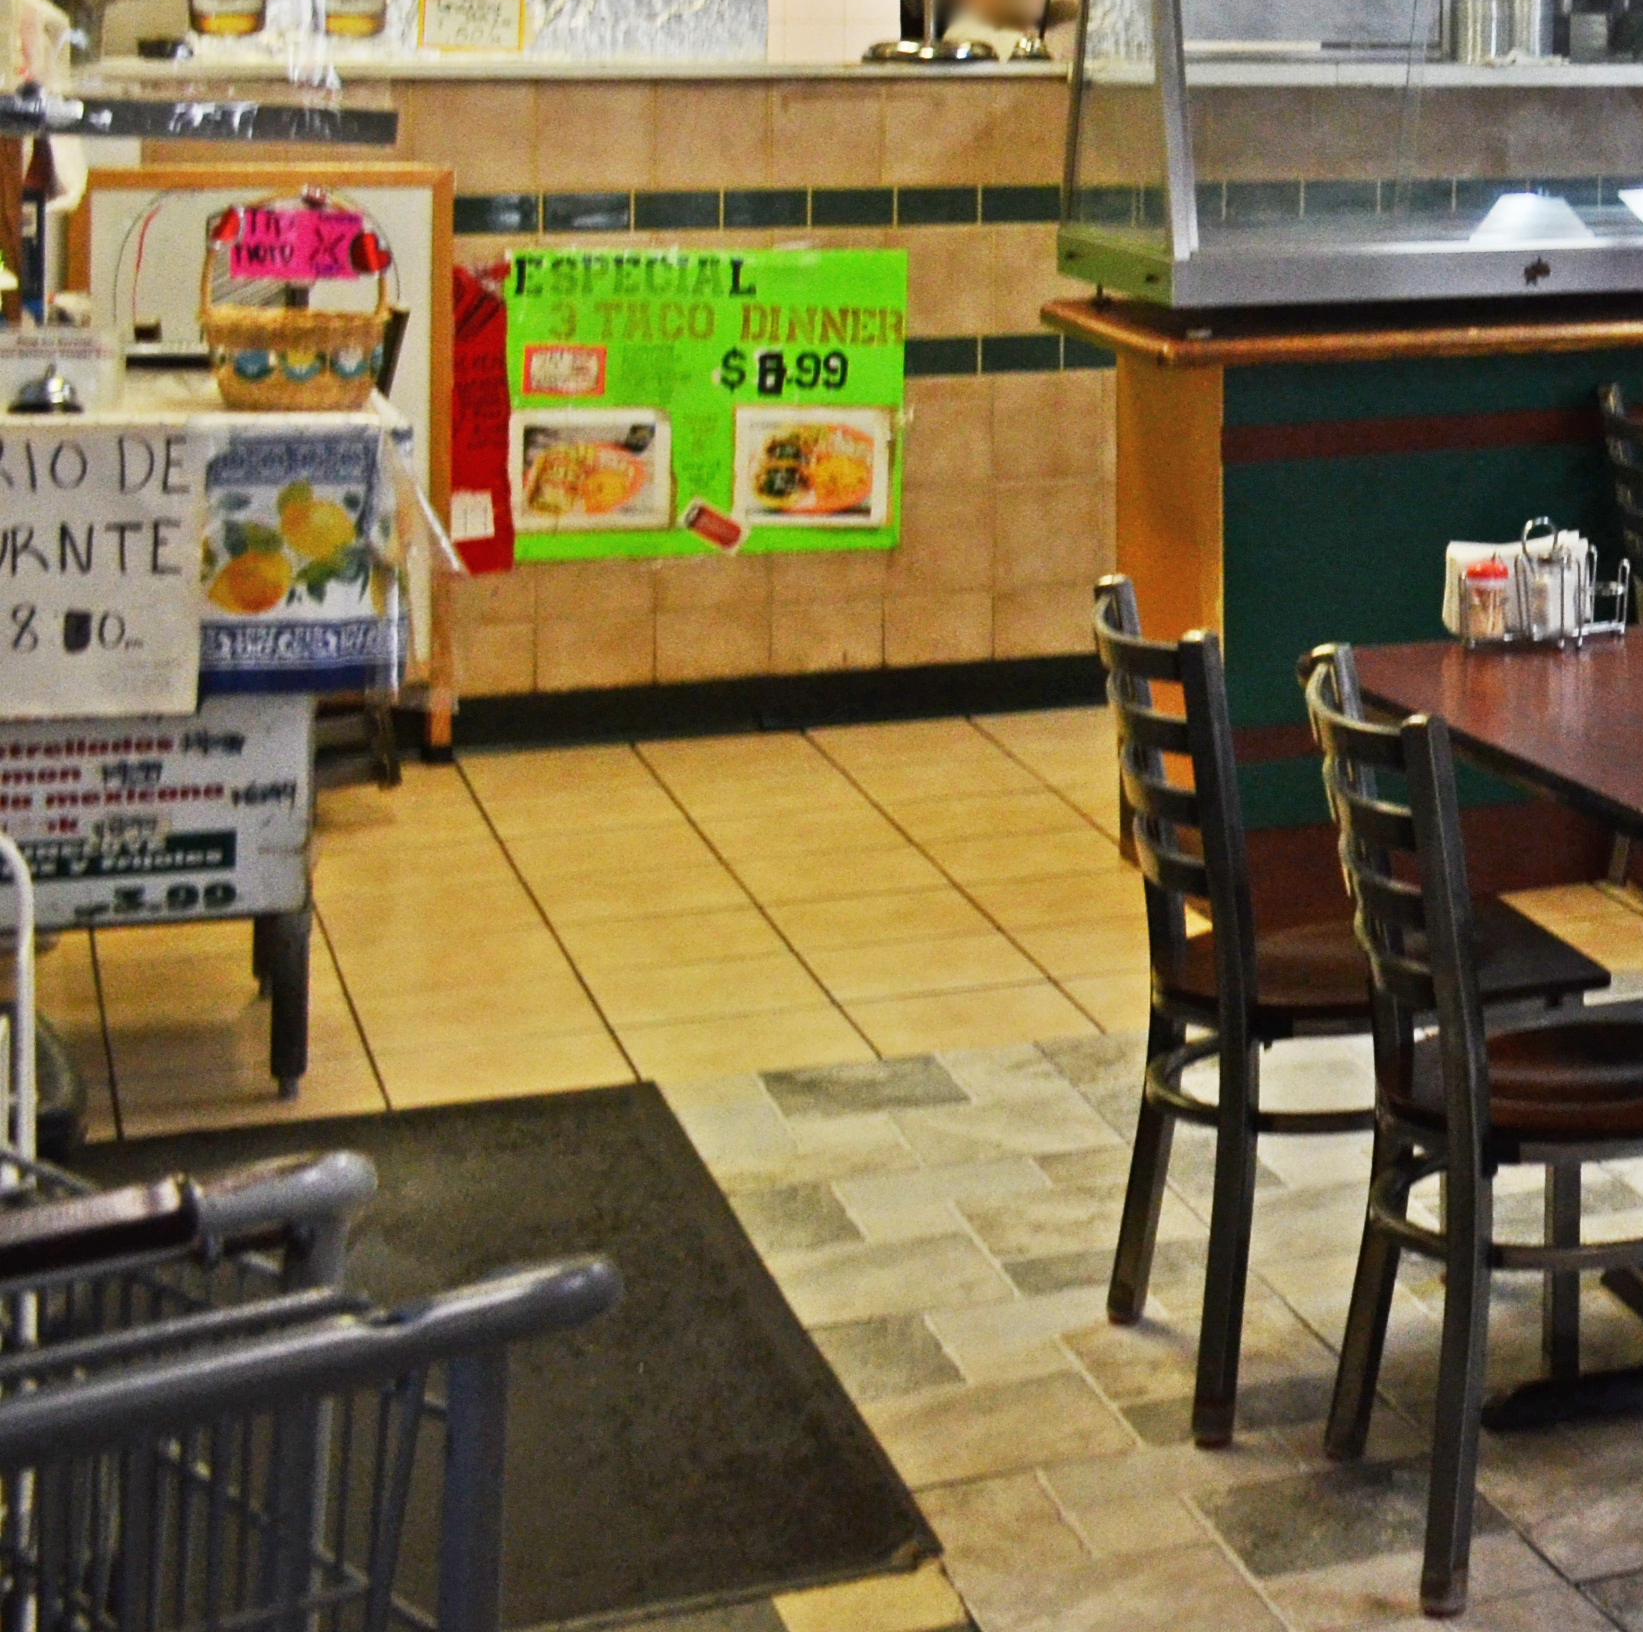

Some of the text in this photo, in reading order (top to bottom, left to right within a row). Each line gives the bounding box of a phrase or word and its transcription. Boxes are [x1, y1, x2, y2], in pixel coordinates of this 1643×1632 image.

[513, 256, 757, 297] ESPECIAL
[550, 302, 906, 347] 3 TACO DINNER
[117, 434, 190, 495] DE
